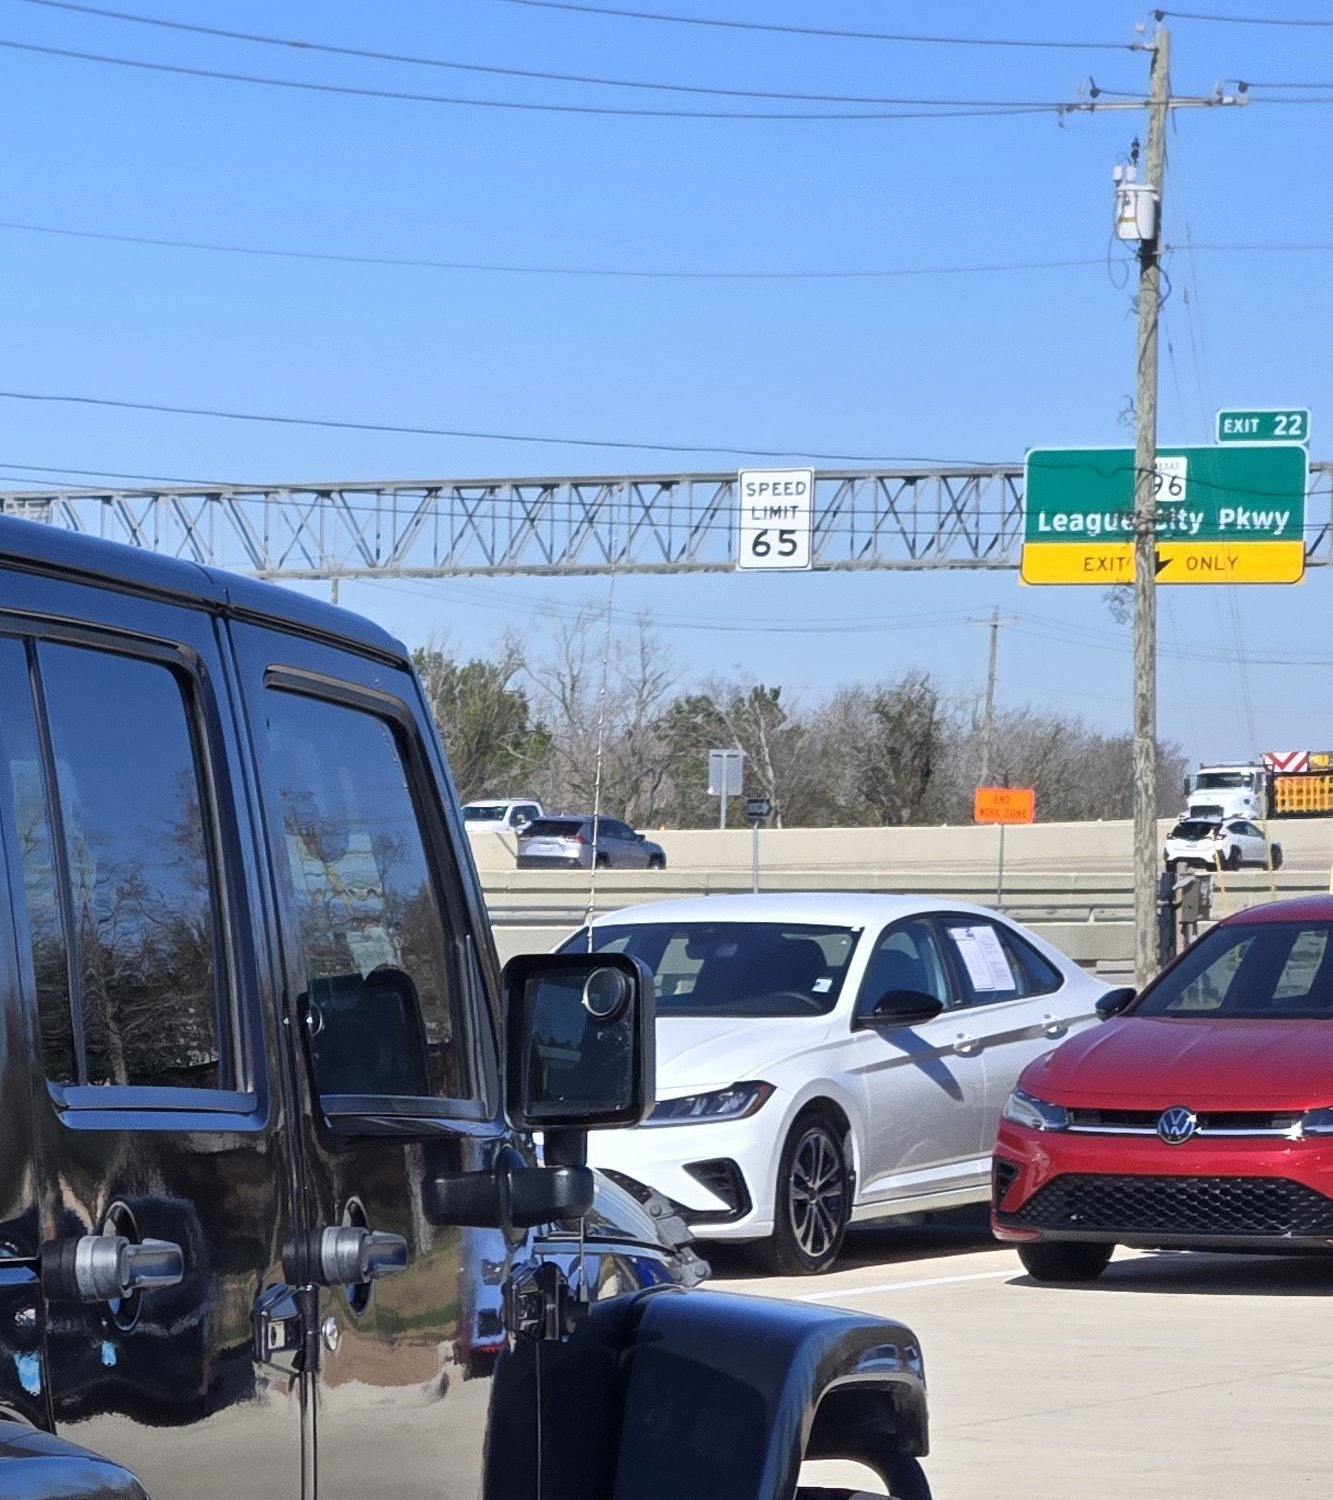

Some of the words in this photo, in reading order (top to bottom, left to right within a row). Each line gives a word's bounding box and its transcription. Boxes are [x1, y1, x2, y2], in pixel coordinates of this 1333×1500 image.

[1223, 418, 1259, 433] EXIT
[1273, 415, 1302, 436] 22
[746, 481, 806, 497] SPEED
[751, 505, 799, 520] LIMIT
[1219, 507, 1290, 535] Pkwy
[751, 528, 798, 557] 65
[1083, 556, 1124, 572] EXIT
[1186, 556, 1239, 571] ONLY
